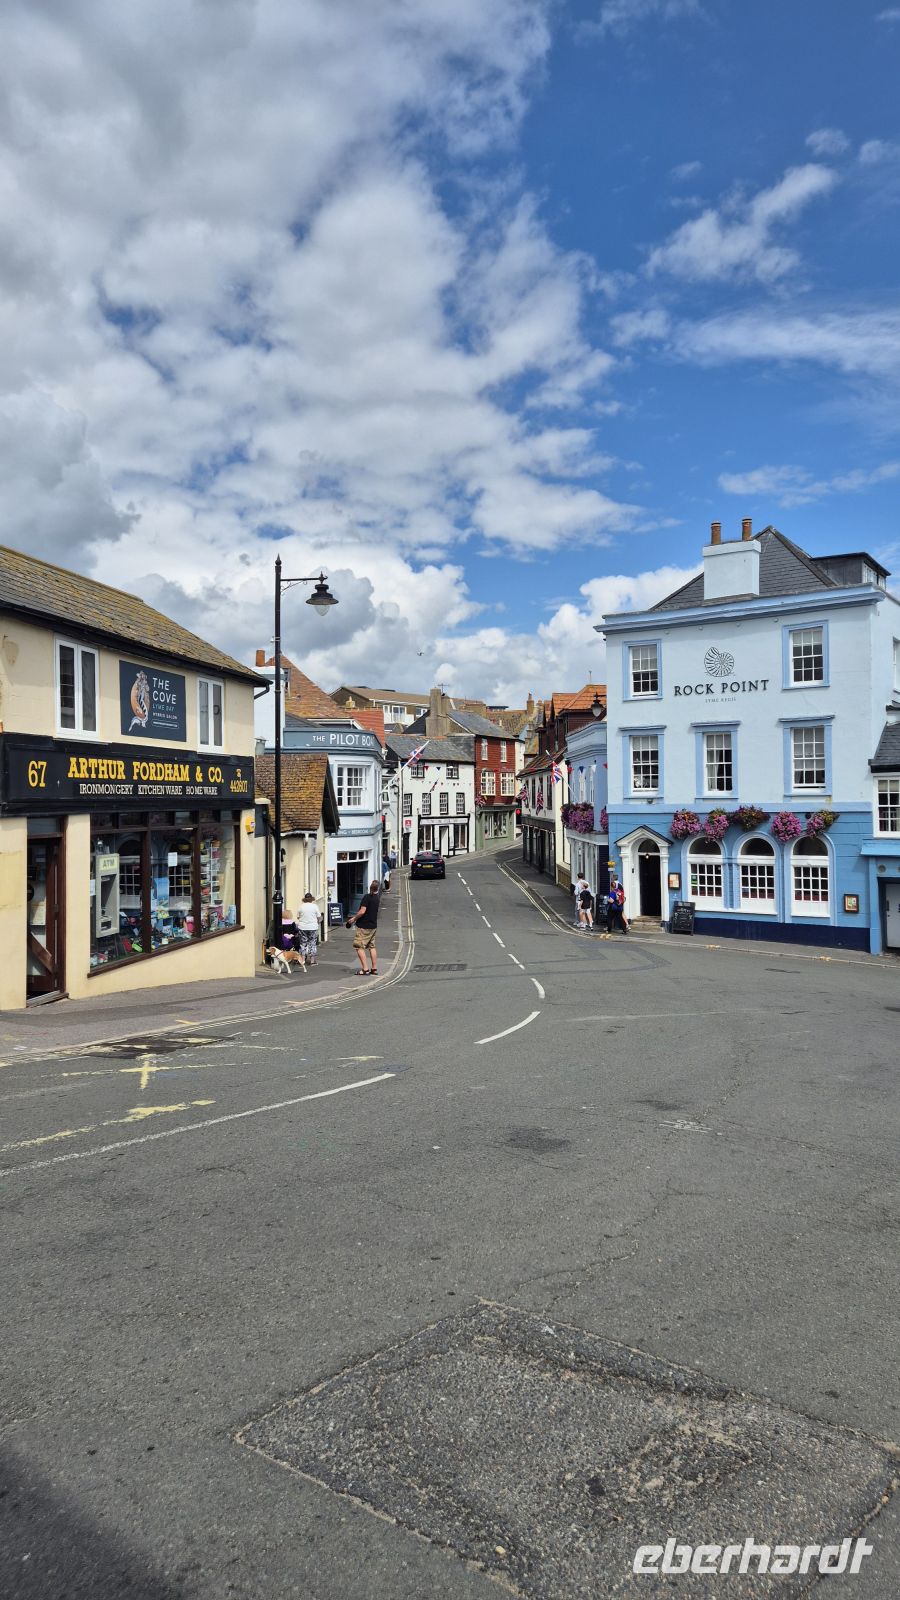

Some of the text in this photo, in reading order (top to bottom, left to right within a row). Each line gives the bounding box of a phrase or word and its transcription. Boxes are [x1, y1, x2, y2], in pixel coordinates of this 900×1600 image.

[152, 677, 170, 691] THE
[673, 679, 769, 697] ROCK POINT
[152, 690, 177, 705] COVE
[329, 733, 360, 745] PILOT
[27, 760, 48, 788] 67
[67, 756, 225, 783] ARTHUR FORDHAM & CO.
[79, 783, 134, 795] IRONMONGERY
[102, 858, 115, 869] ATM
